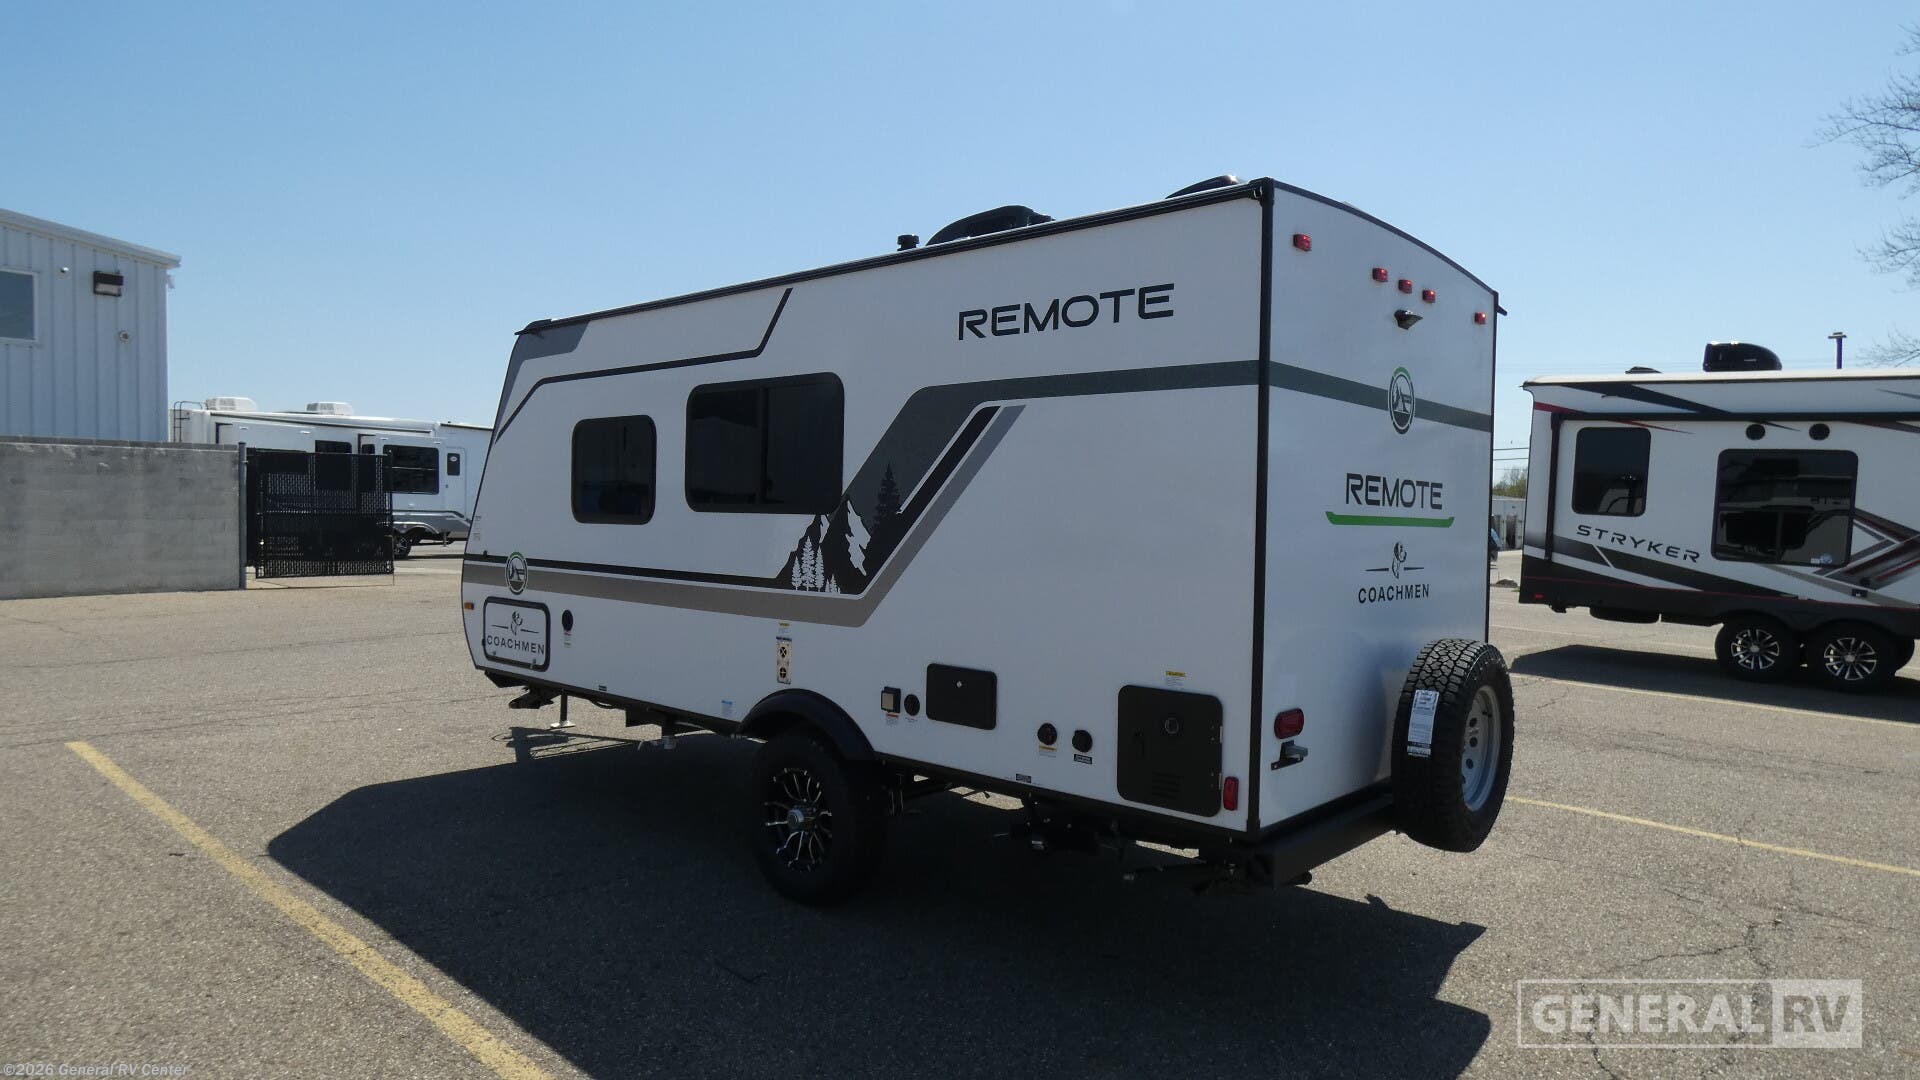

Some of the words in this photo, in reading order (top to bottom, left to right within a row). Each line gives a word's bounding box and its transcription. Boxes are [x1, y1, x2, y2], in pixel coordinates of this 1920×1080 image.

[958, 282, 1175, 341] REMOTE
[1345, 472, 1443, 510] REMOTE
[1576, 524, 1700, 563] STRYKER
[1358, 583, 1430, 604] COACHMEN
[486, 635, 546, 655] COACHMEN
